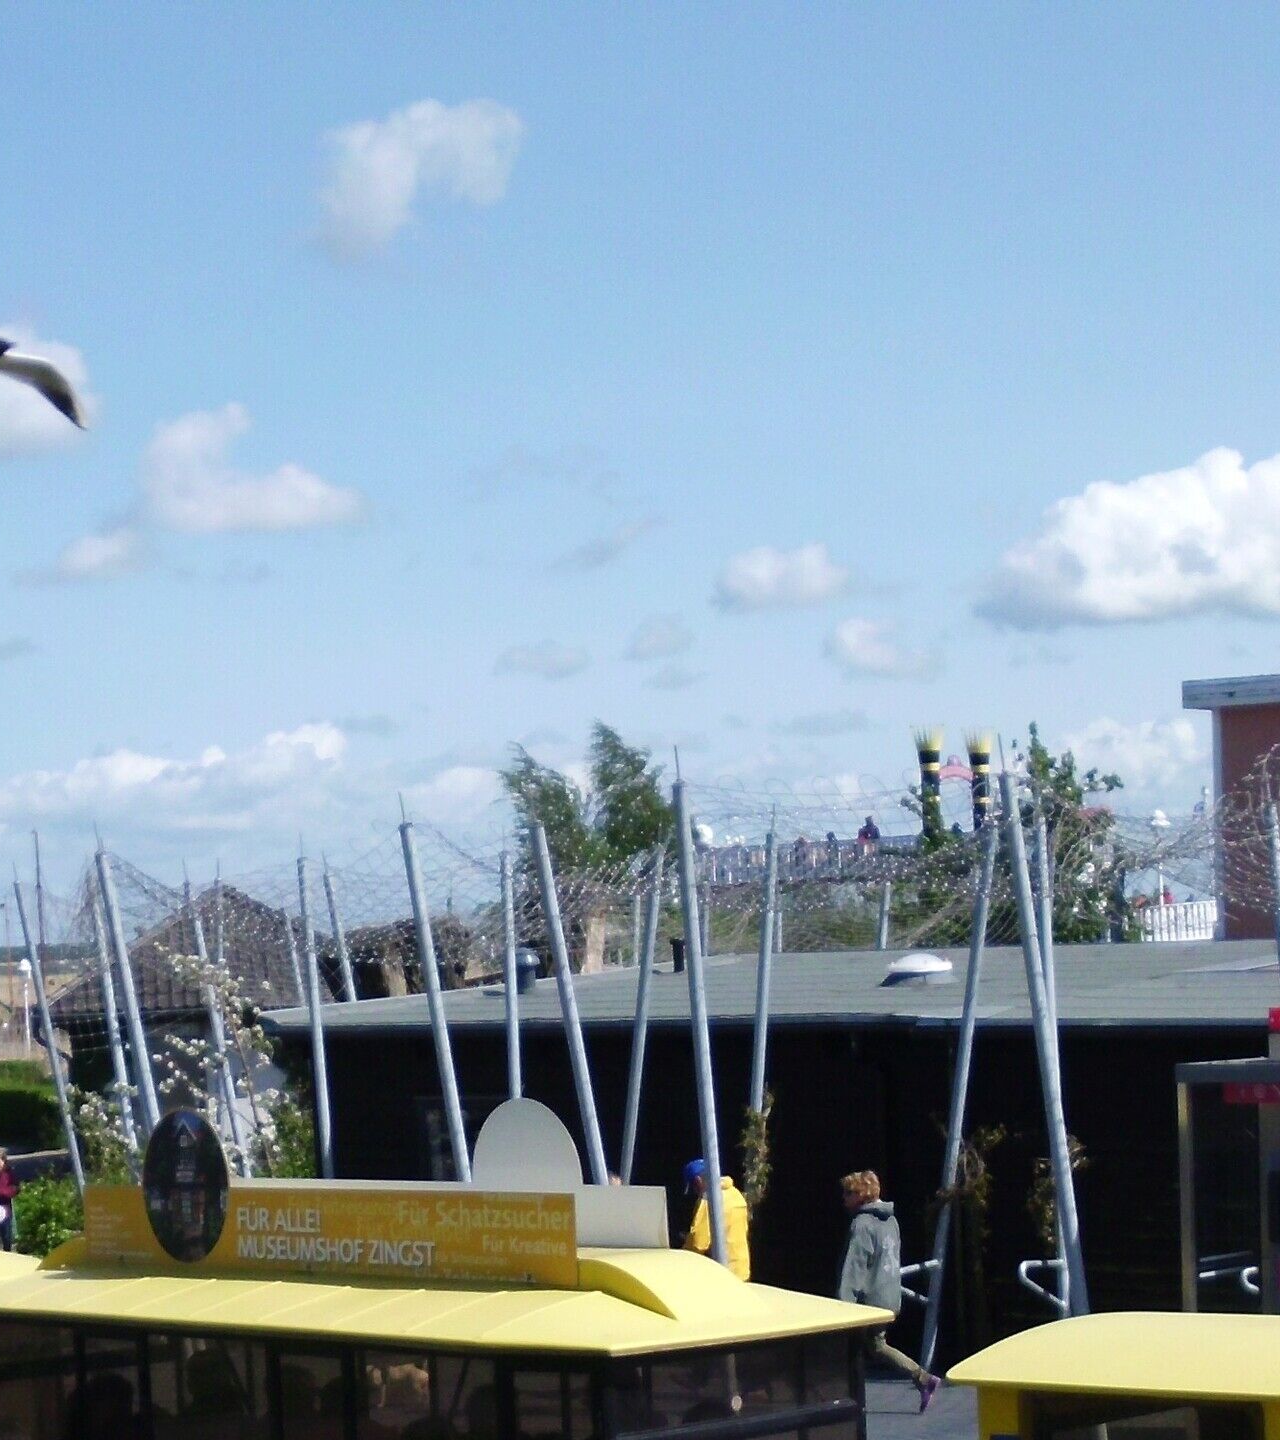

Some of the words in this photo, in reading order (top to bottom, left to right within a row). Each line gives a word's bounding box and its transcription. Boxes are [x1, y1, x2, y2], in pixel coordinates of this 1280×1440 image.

[236, 1202, 269, 1231] FÜR
[274, 1207, 321, 1233] ALLE!
[397, 1200, 430, 1226] Für
[436, 1201, 572, 1231] Schatzsucher
[237, 1234, 363, 1264] MUSEUMSHOF
[368, 1239, 436, 1267] ZINGST
[482, 1234, 505, 1252] Für
[509, 1236, 567, 1257] Kreative
